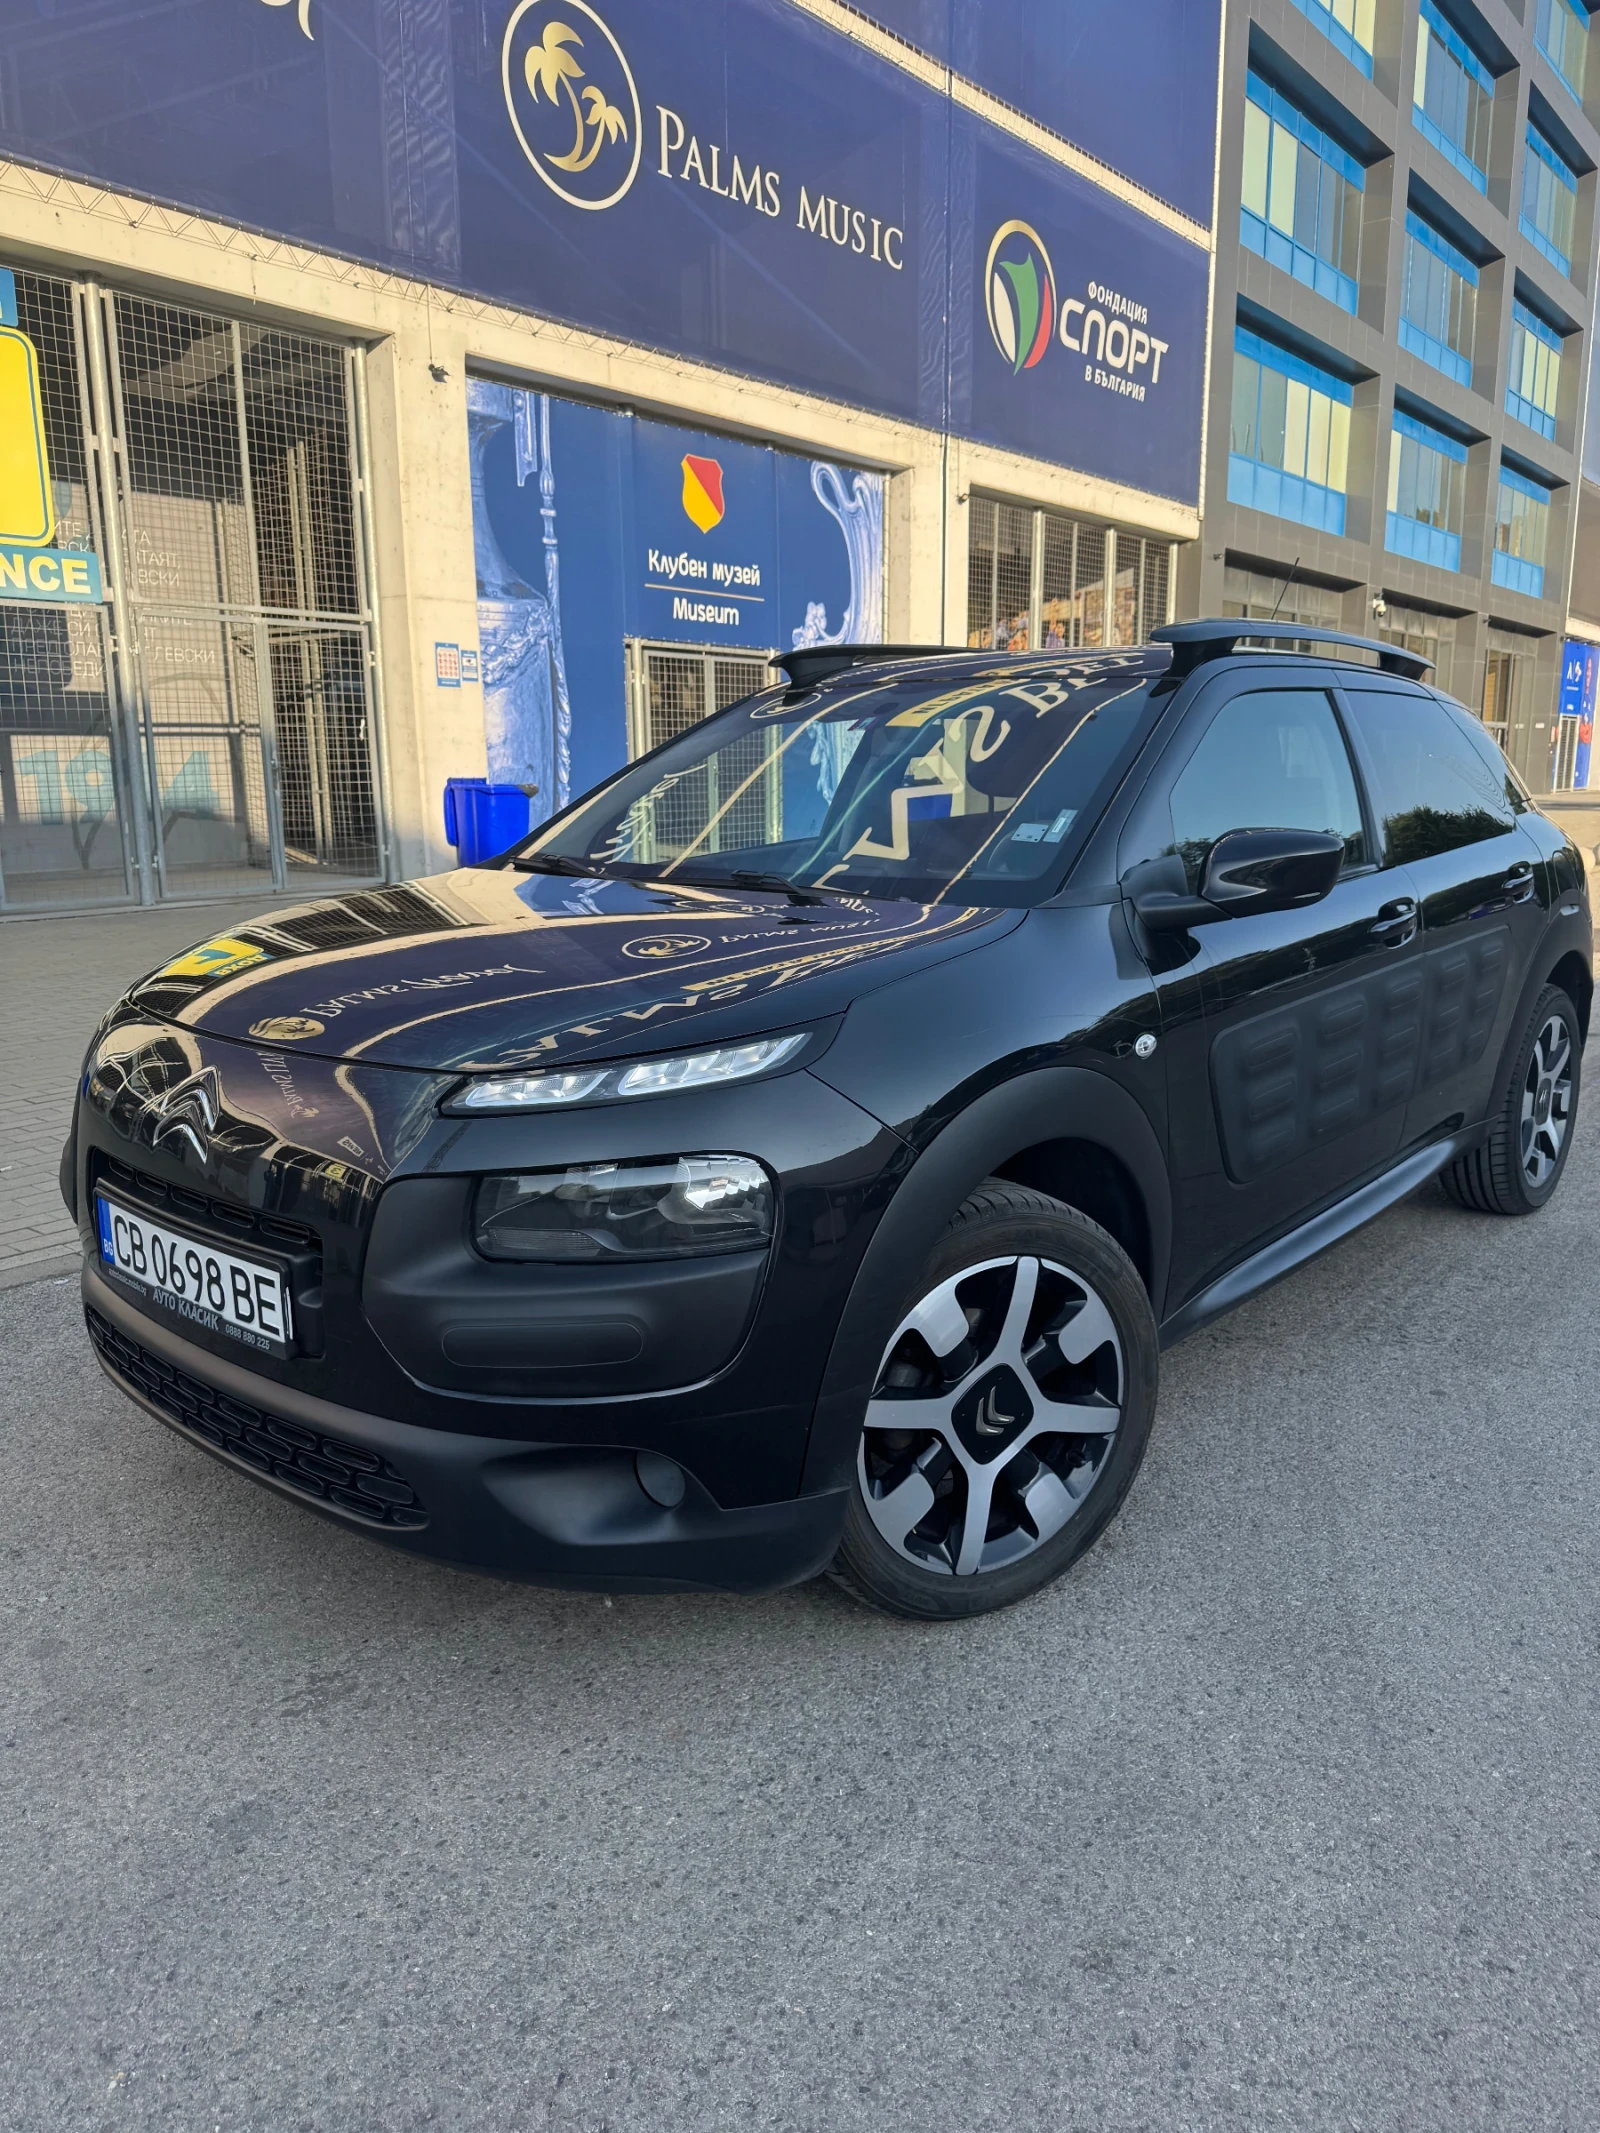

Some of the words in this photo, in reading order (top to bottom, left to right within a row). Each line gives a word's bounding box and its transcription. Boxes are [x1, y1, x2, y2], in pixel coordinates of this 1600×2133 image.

[796, 185, 904, 270] MUSIC
[1088, 280, 1148, 325] ФОНДАЦИЯ
[1059, 298, 1170, 385] СПОРТ
[1084, 364, 1093, 382] В
[1094, 368, 1146, 403] БЪЛГАРИЯ
[648, 548, 708, 580] Клубен
[712, 562, 761, 588] музей
[672, 597, 740, 626] Museum
[103, 1238, 114, 1256] BG
[151, 1233, 226, 1312] 0698
[230, 1264, 280, 1337] BE
[152, 1287, 176, 1311] АУТО
[178, 1300, 220, 1332] КЛАСИК
[256, 1336, 271, 1350] 225
